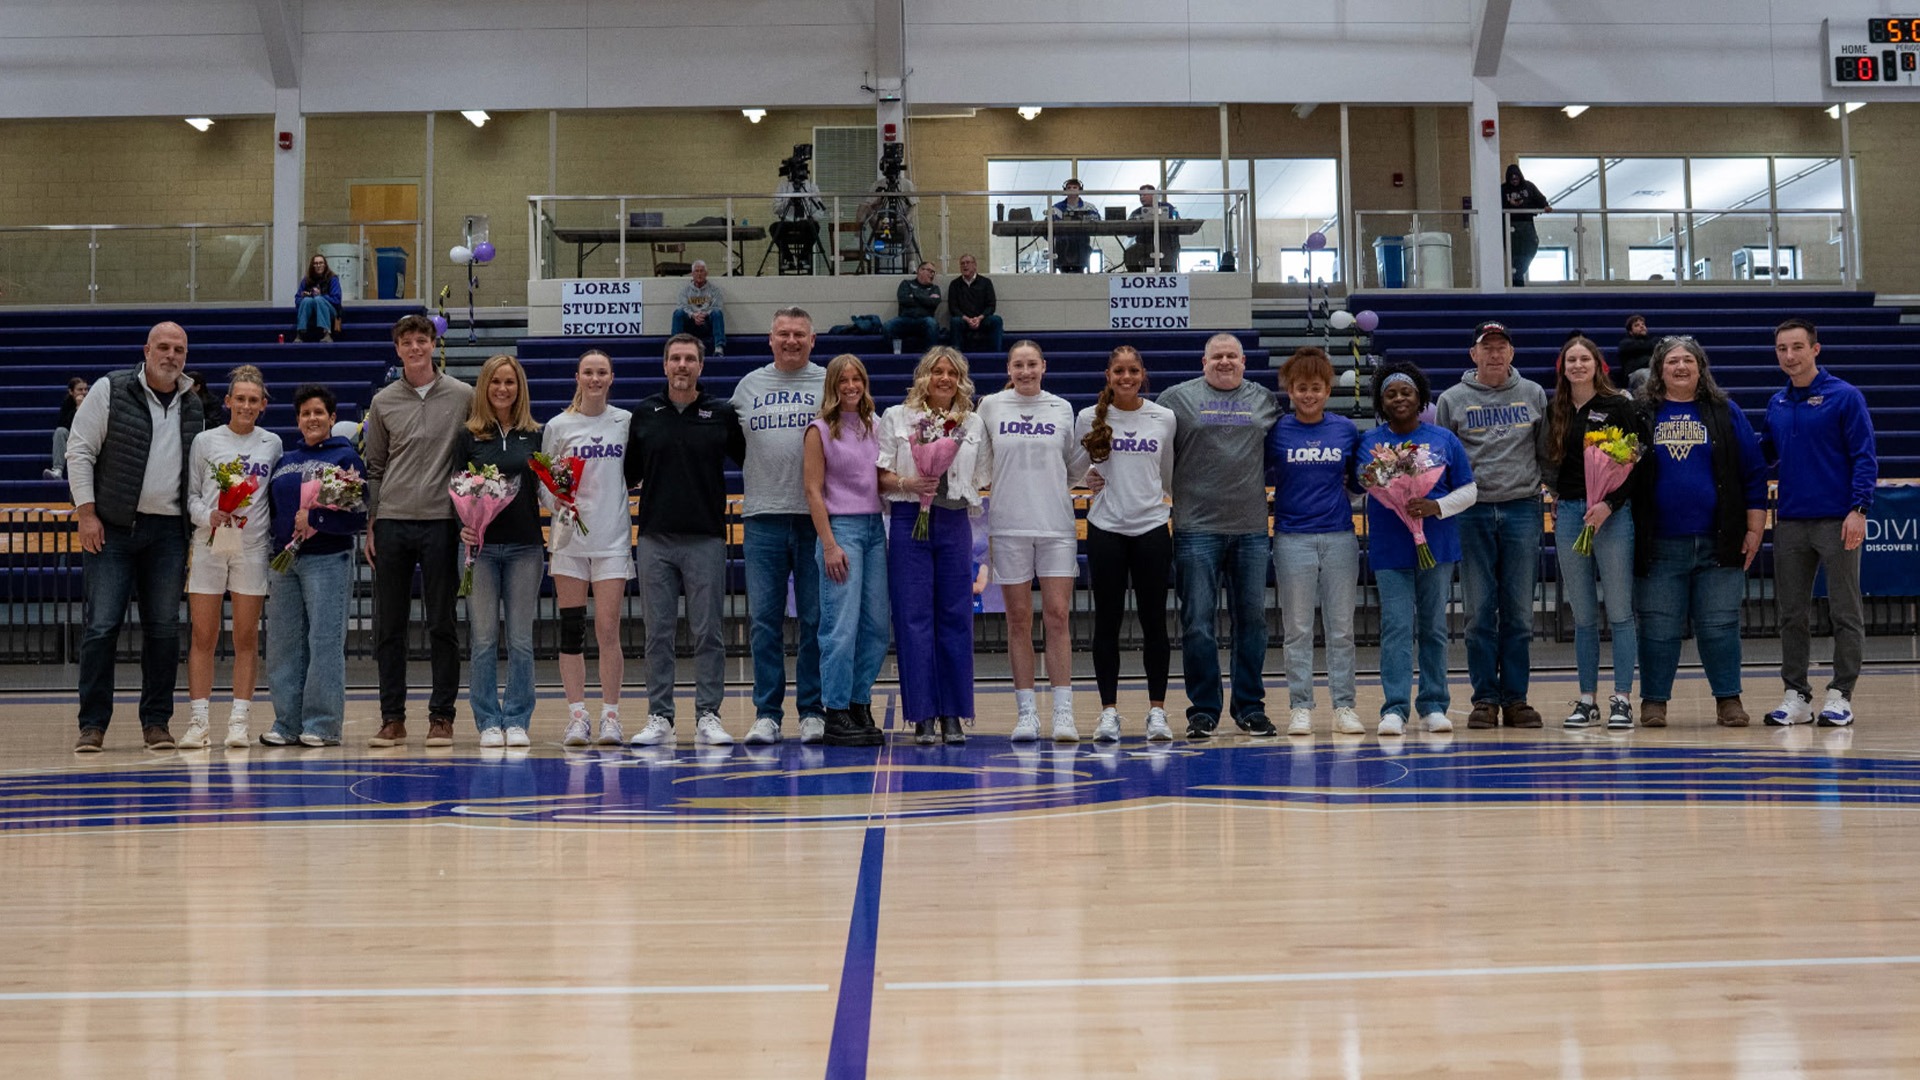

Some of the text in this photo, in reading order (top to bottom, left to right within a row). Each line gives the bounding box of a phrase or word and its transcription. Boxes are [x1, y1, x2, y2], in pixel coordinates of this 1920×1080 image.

[1841, 45, 1868, 54] HOME
[573, 282, 630, 294] LORAS
[1121, 276, 1177, 288] LORAS
[563, 302, 642, 315] STUDENT
[1110, 296, 1189, 308] STUDENT
[563, 322, 641, 335] SECTION
[1111, 316, 1189, 328] SECTION
[753, 391, 815, 410] LORAS
[750, 412, 816, 431] COLLEGE
[1467, 406, 1530, 429] DUHAWKS
[999, 421, 1056, 435] LORAS
[1658, 420, 1702, 431] CONFERENCE
[1656, 430, 1704, 441] CHAMPIONS
[573, 443, 623, 459] LORAS
[1110, 438, 1158, 453] ORAS
[1287, 447, 1342, 463] LORAS
[218, 462, 269, 478] RAS
[1865, 518, 1918, 540] DIVI
[1866, 544, 1913, 552] DISCOVER
